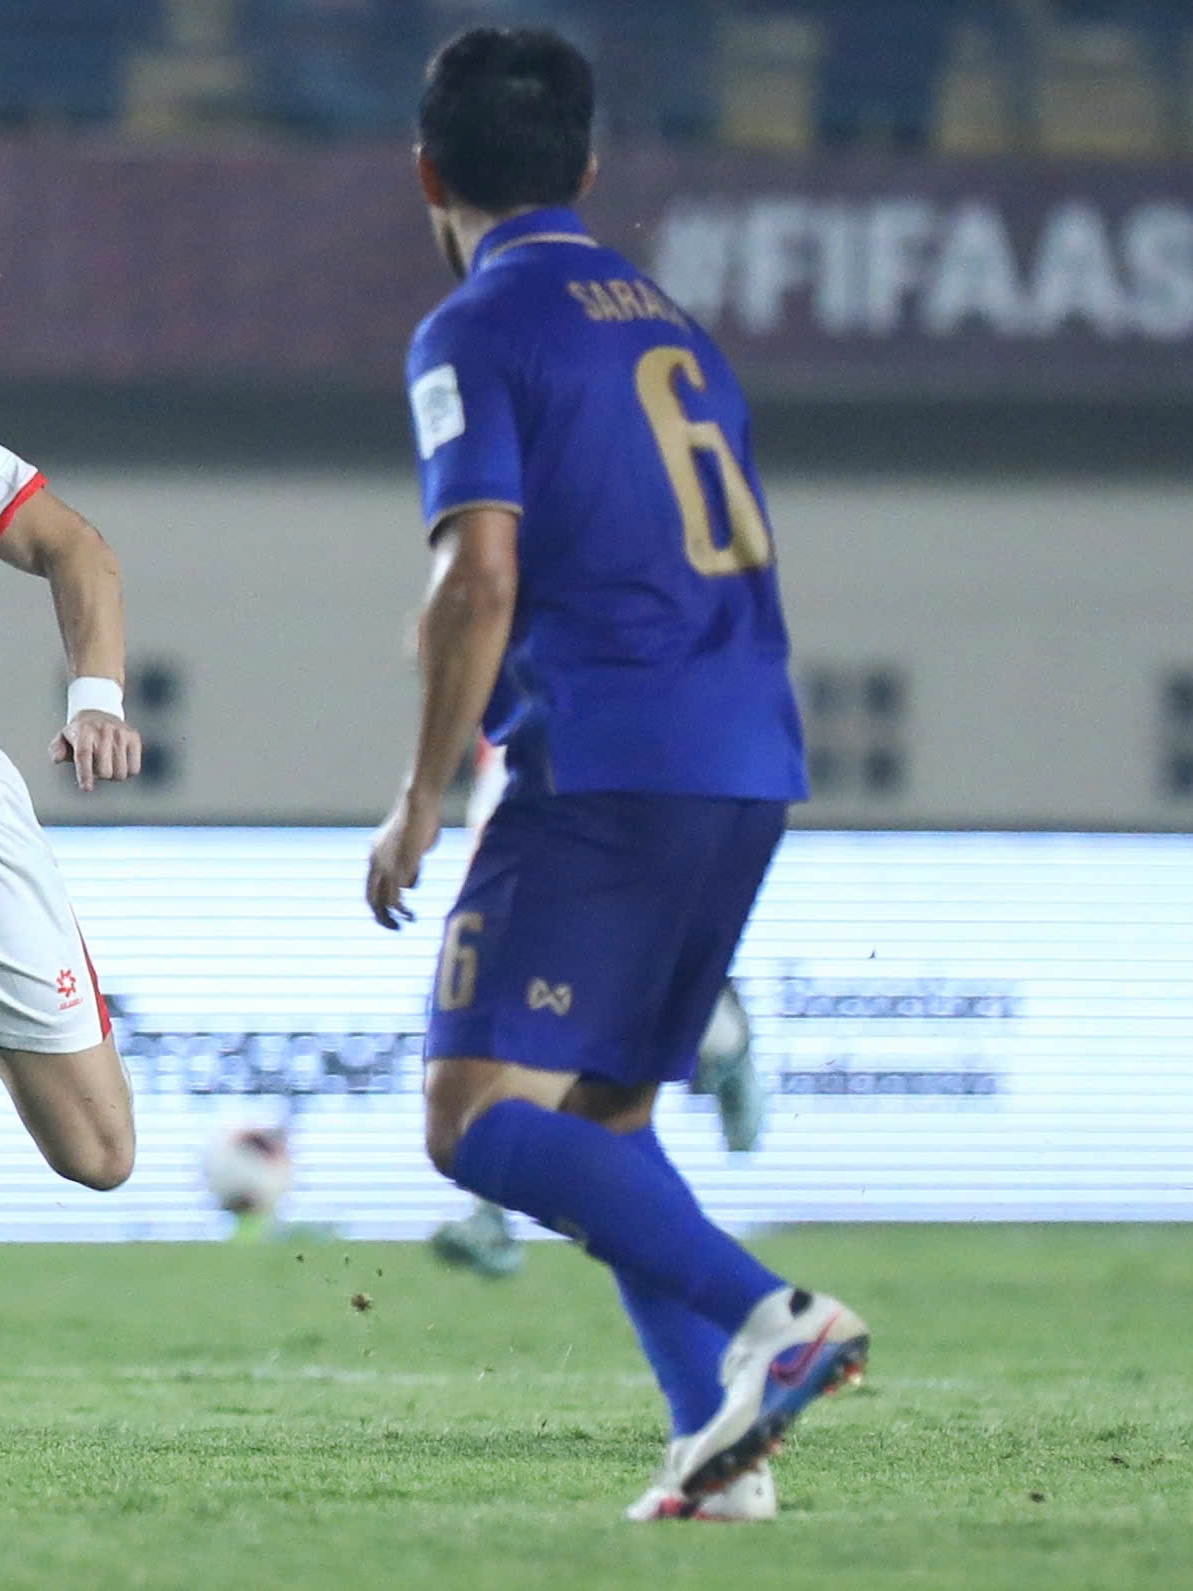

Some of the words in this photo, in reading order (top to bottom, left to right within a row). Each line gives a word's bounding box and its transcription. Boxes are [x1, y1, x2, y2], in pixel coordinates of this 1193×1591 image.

[568, 280, 691, 333] SARA
[634, 346, 773, 576] 6
[437, 912, 482, 1011] 6
